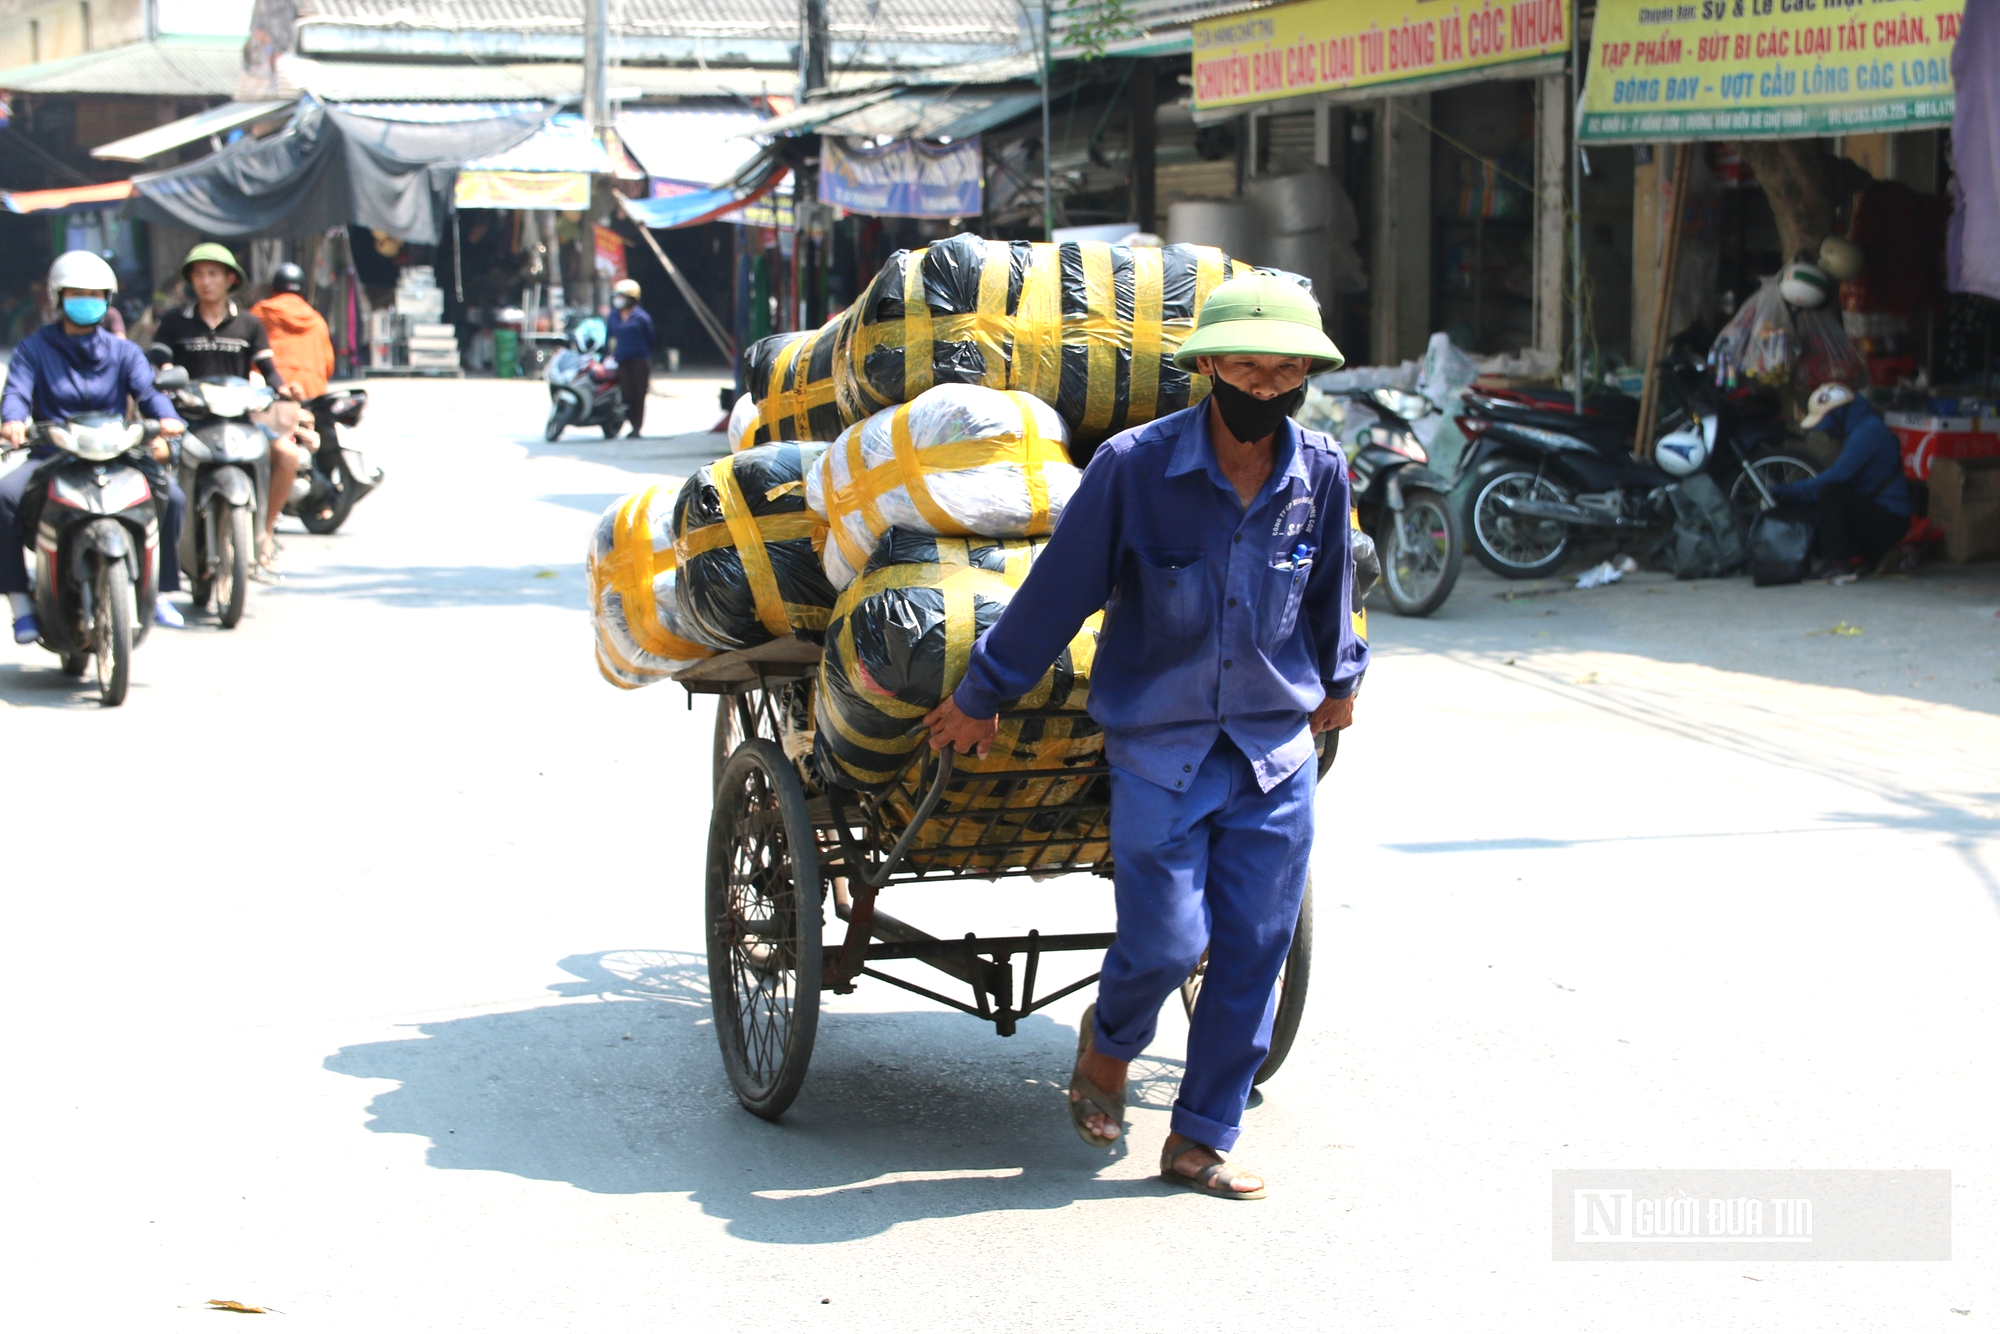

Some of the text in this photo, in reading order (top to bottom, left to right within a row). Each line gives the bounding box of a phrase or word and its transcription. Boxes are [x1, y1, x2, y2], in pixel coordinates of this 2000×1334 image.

[1197, 47, 1250, 102] CHUYÊN
[1254, 41, 1284, 93] BÁN
[1287, 33, 1318, 88] CÁC
[1320, 34, 1356, 88] LOẠI
[1358, 20, 1384, 78] TÚI
[1388, 14, 1435, 73] BÓNG
[1440, 5, 1463, 63] VÀ
[1601, 42, 1631, 74] TẠP
[1733, 33, 1752, 60] BI
[1755, 24, 1790, 59] CÁC
[1794, 25, 1832, 61] LOẠI
[1613, 74, 1660, 104] BÓNG
[1665, 75, 1700, 102] BAY
[1802, 62, 1850, 96] LÔNG
[1856, 57, 1894, 92] CÁC
[1901, 56, 1950, 91] LOẠI
